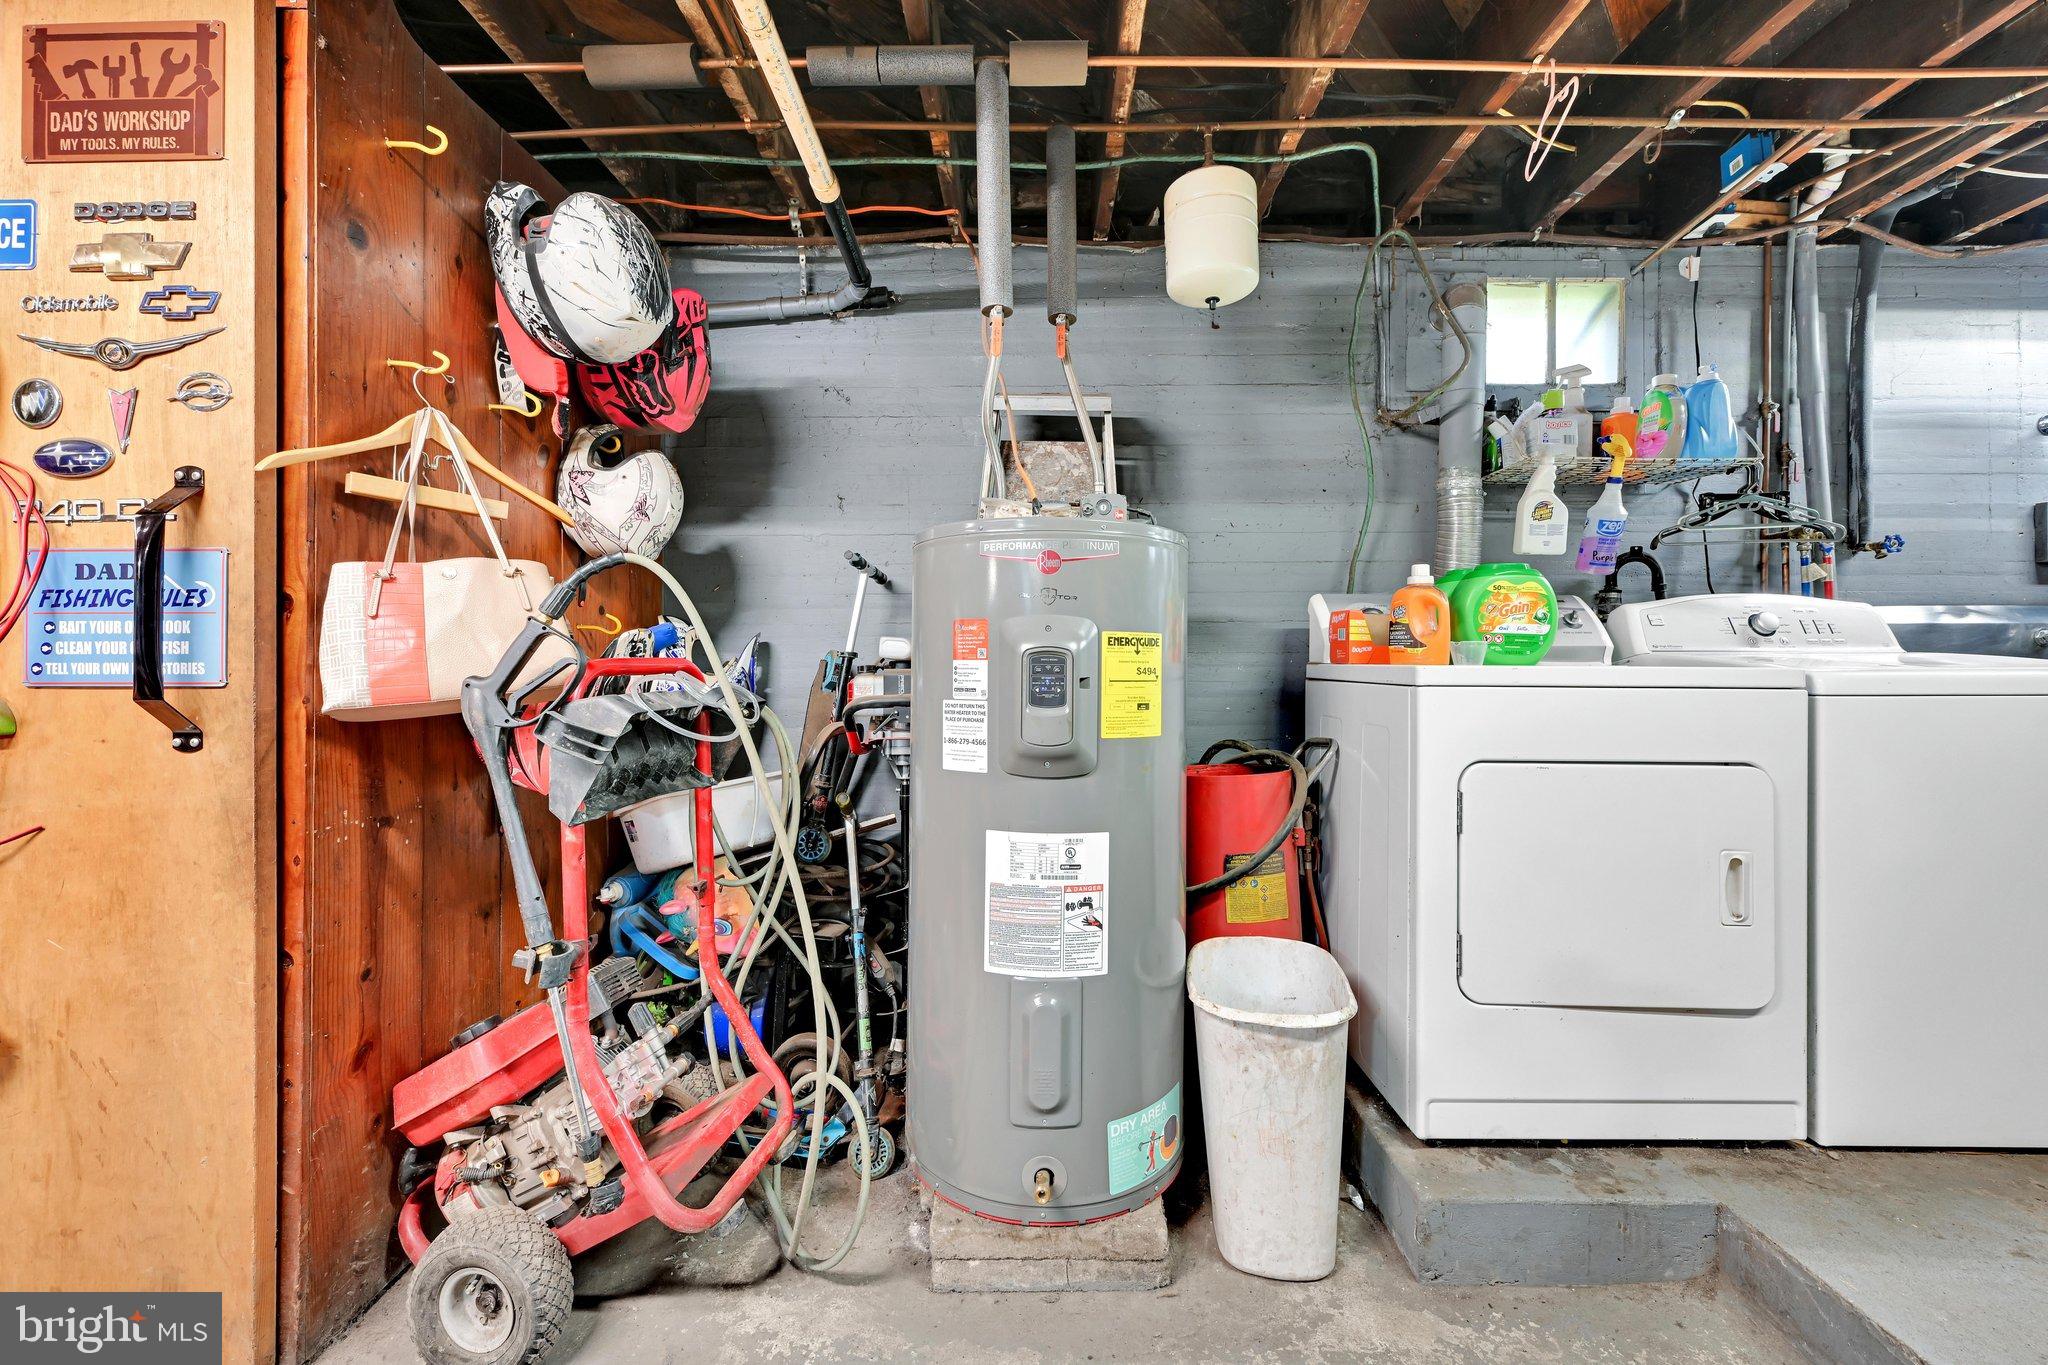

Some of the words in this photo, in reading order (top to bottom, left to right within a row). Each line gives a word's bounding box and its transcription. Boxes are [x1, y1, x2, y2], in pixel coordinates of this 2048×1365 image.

[50, 109, 98, 133] DAD'S
[103, 109, 191, 132] WORKSHOP
[60, 138, 79, 151] MY
[81, 137, 120, 150] TOOLS.
[122, 137, 140, 150] MY
[142, 136, 180, 149] RULES.
[74, 201, 197, 220] DODGE
[20, 293, 119, 312] Oldsmobile
[74, 563, 135, 581] DAD
[38, 588, 134, 608] FISHING
[161, 588, 208, 608] ULES
[1499, 602, 1530, 619] Gain
[58, 620, 87, 634] BAIT
[89, 620, 121, 634] YOUR
[163, 620, 191, 634] OOK
[55, 641, 92, 655] CLEAN
[94, 640, 127, 655] YOUR
[45, 662, 69, 675] TELL
[71, 662, 100, 675] YOUR
[102, 662, 129, 675] OWN
[1110, 1117, 1137, 1137] DRY
[1140, 1101, 1167, 1126] AREA
